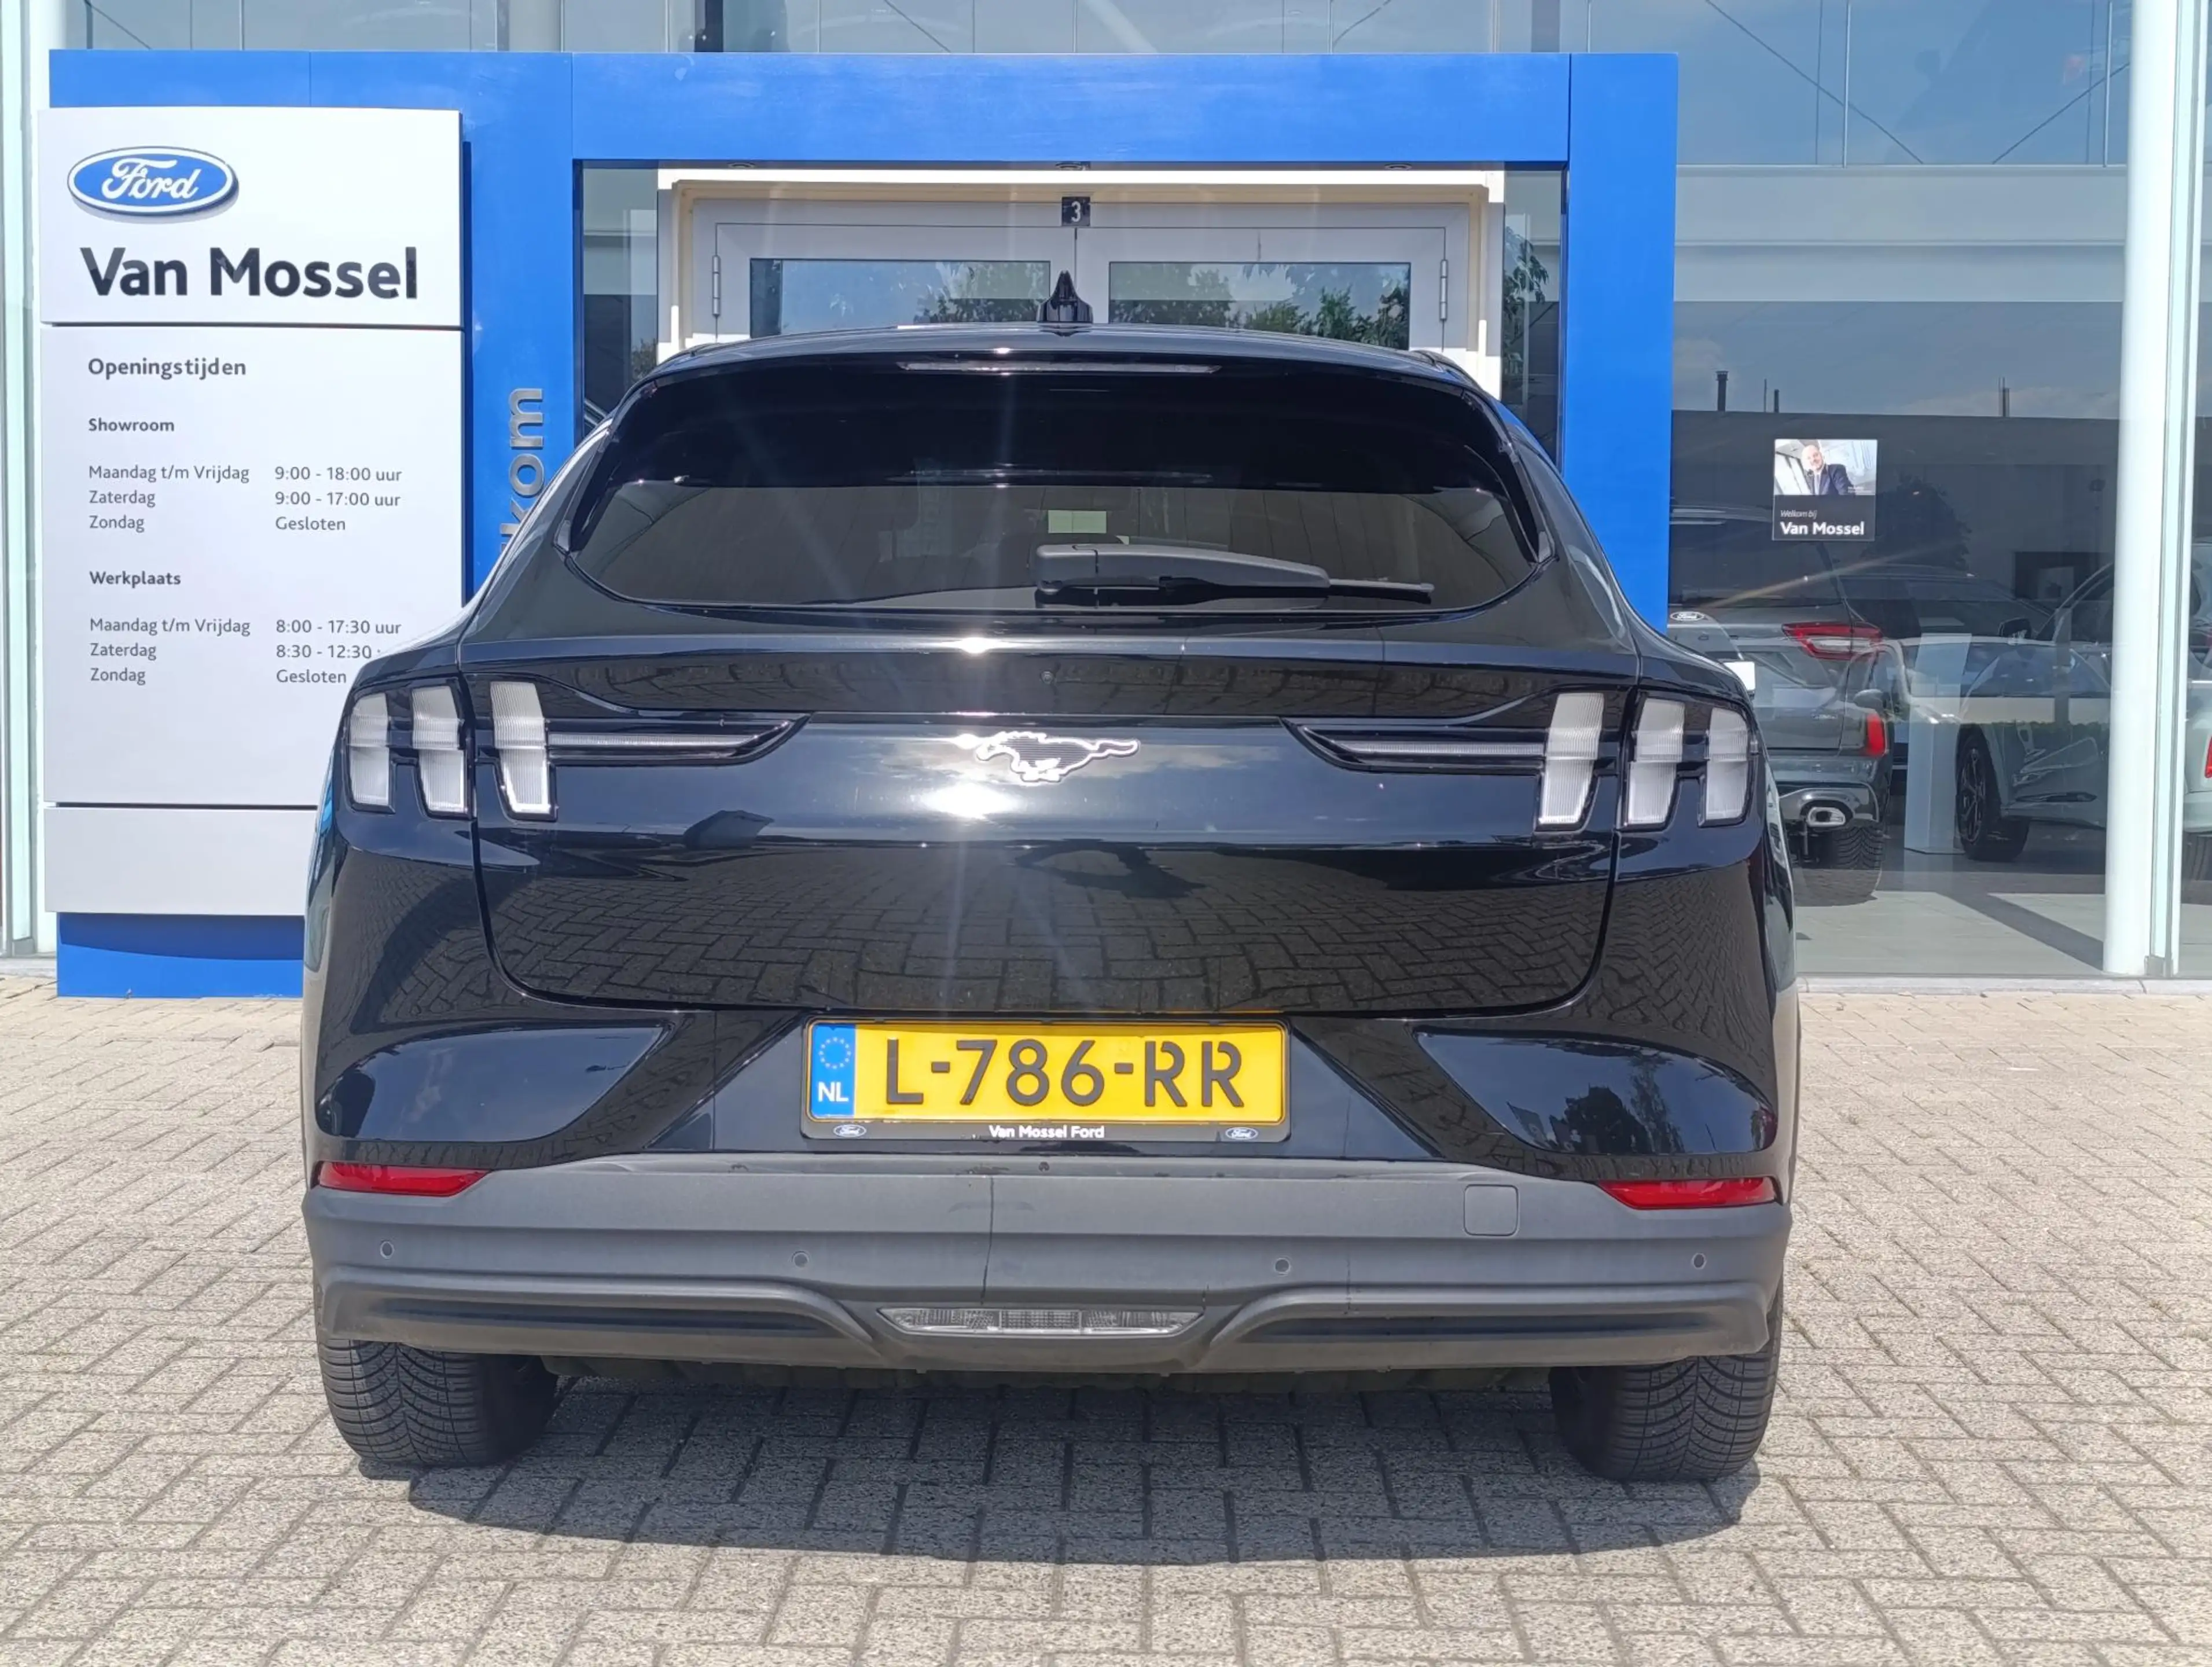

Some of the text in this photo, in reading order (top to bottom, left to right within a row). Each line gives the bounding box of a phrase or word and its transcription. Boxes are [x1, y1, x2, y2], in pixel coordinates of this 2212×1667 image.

[101, 157, 202, 200] Ford
[1071, 201, 1081, 223] 3
[80, 246, 418, 300] Van Mossel
[87, 357, 247, 381] Openingstijden
[88, 417, 175, 432] Showroom
[89, 464, 157, 483] Maandag
[160, 464, 189, 480] t/m
[193, 464, 250, 484] Vrijdag
[274, 466, 311, 480] 9:00
[326, 467, 371, 482] 18:00
[376, 471, 403, 482] uur
[89, 489, 156, 509] Zaterdag
[275, 491, 311, 506] 9:00
[326, 491, 370, 506] 17:00
[374, 496, 401, 507] uur
[89, 514, 347, 534] Zondag Gesloten
[1780, 521, 1865, 535] Van Mossel
[89, 570, 181, 589] Werkplaats
[90, 617, 158, 637] Maandag
[161, 618, 190, 633] t/m
[194, 618, 251, 637] Vrijdag
[276, 619, 312, 633] 8:00
[328, 619, 370, 634] 17:30
[375, 623, 402, 634] uur
[90, 642, 157, 662] Zaterdag
[276, 644, 312, 658] 8:30
[327, 644, 372, 659] 12:30
[90, 666, 347, 686] Zondag Gesloten
[885, 1037, 1244, 1108] L-786-RR
[818, 1082, 849, 1103] NL
[989, 1125, 1105, 1139] Van Mossel Ford
